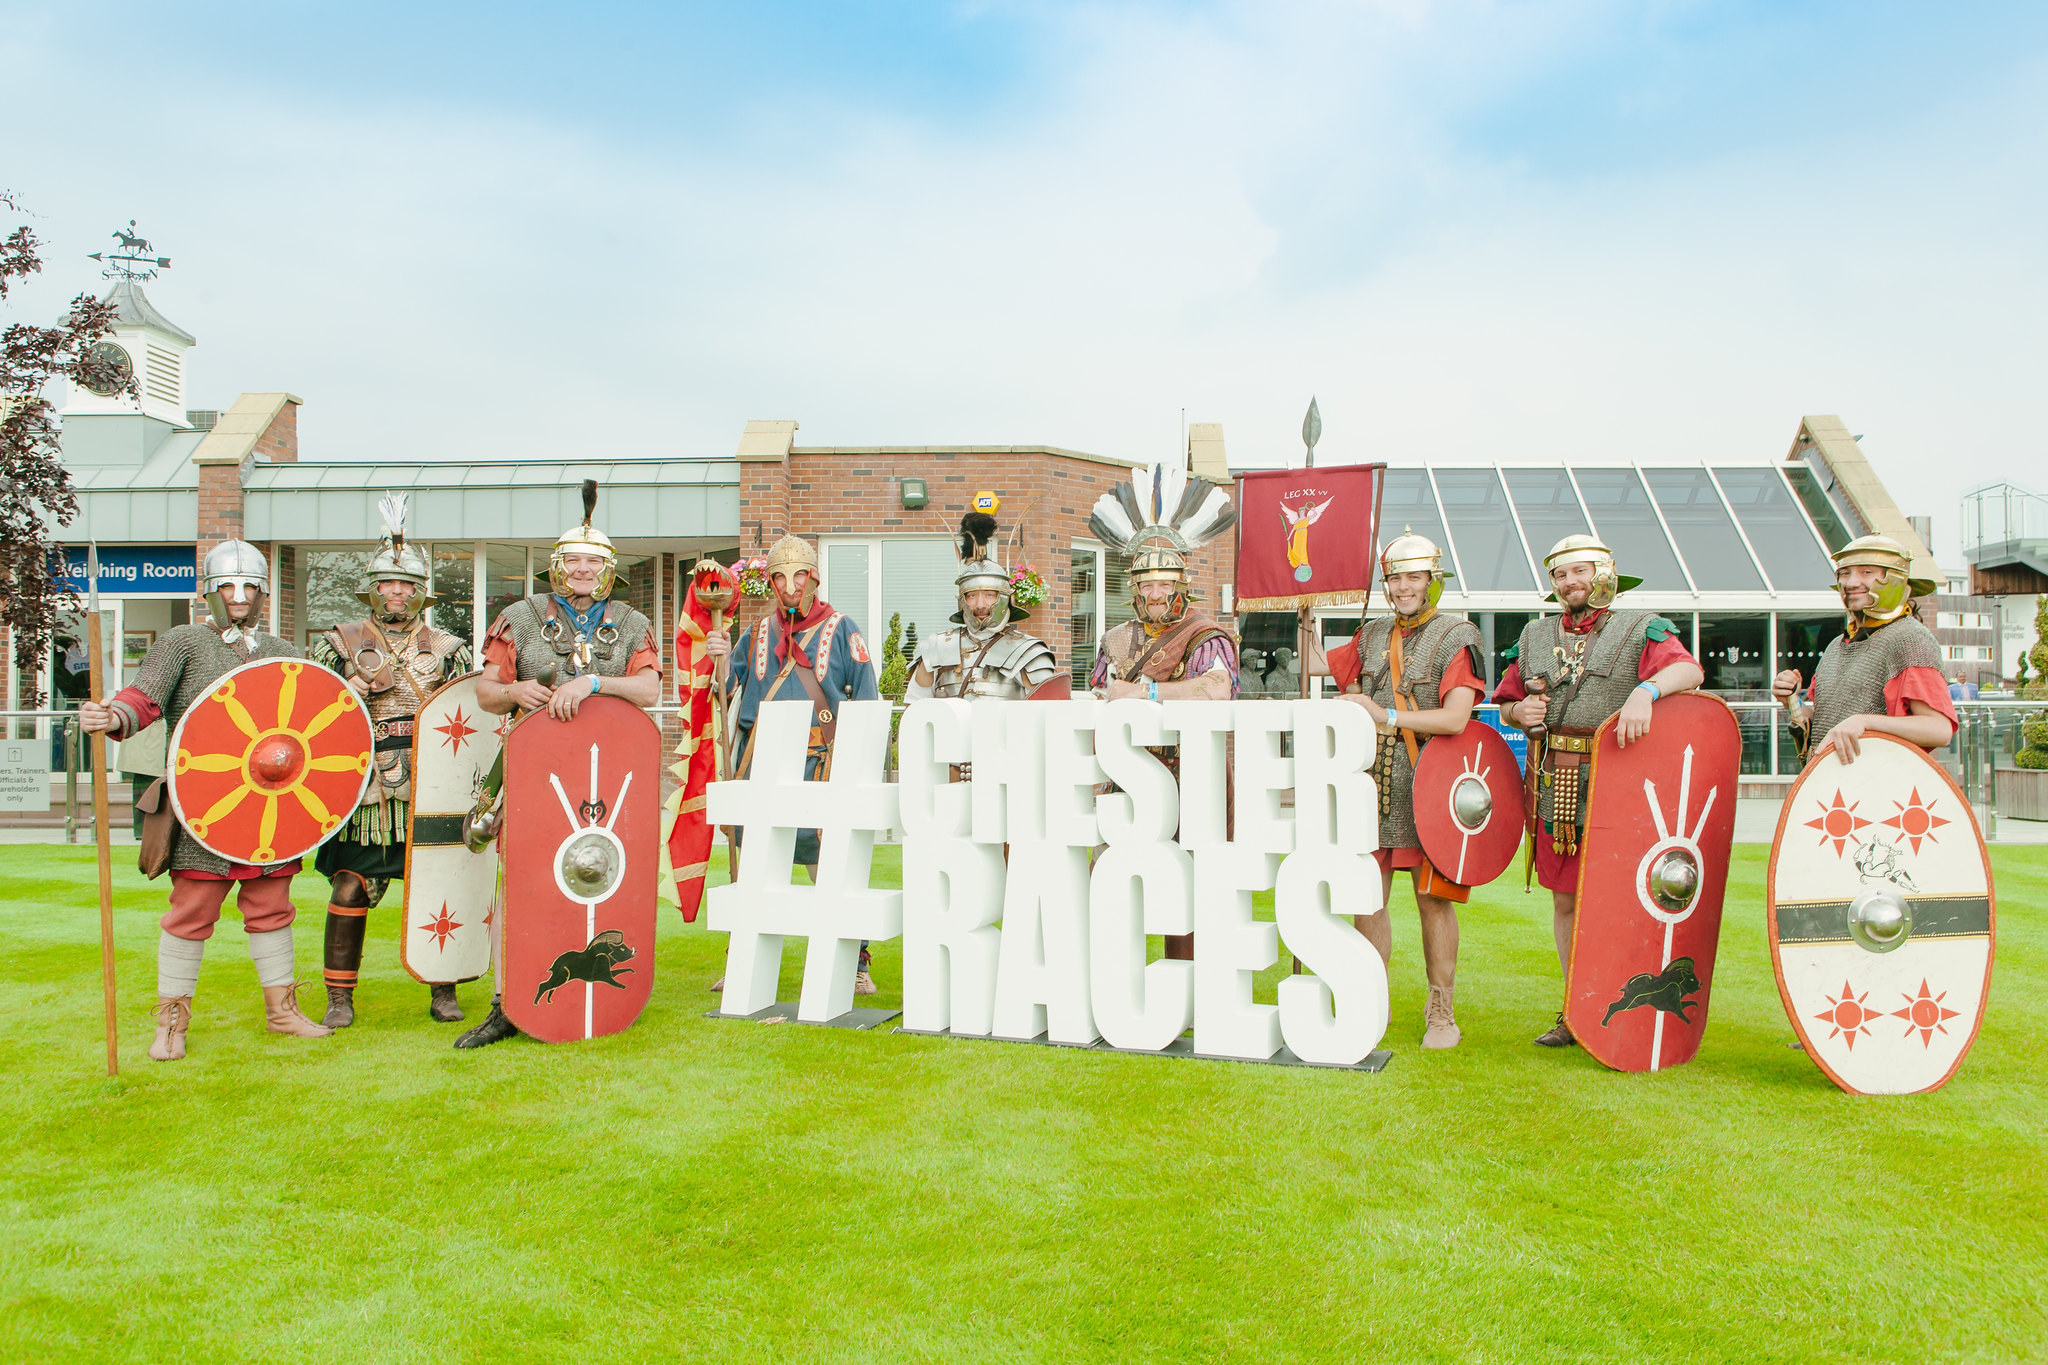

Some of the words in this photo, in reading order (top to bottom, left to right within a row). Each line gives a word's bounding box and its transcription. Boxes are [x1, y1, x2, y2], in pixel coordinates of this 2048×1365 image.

[1302, 488, 1316, 496] XX
[978, 498, 992, 507] ADT
[143, 562, 195, 578] Room
[7, 795, 24, 803] only
[901, 835, 1389, 1066] RACES
